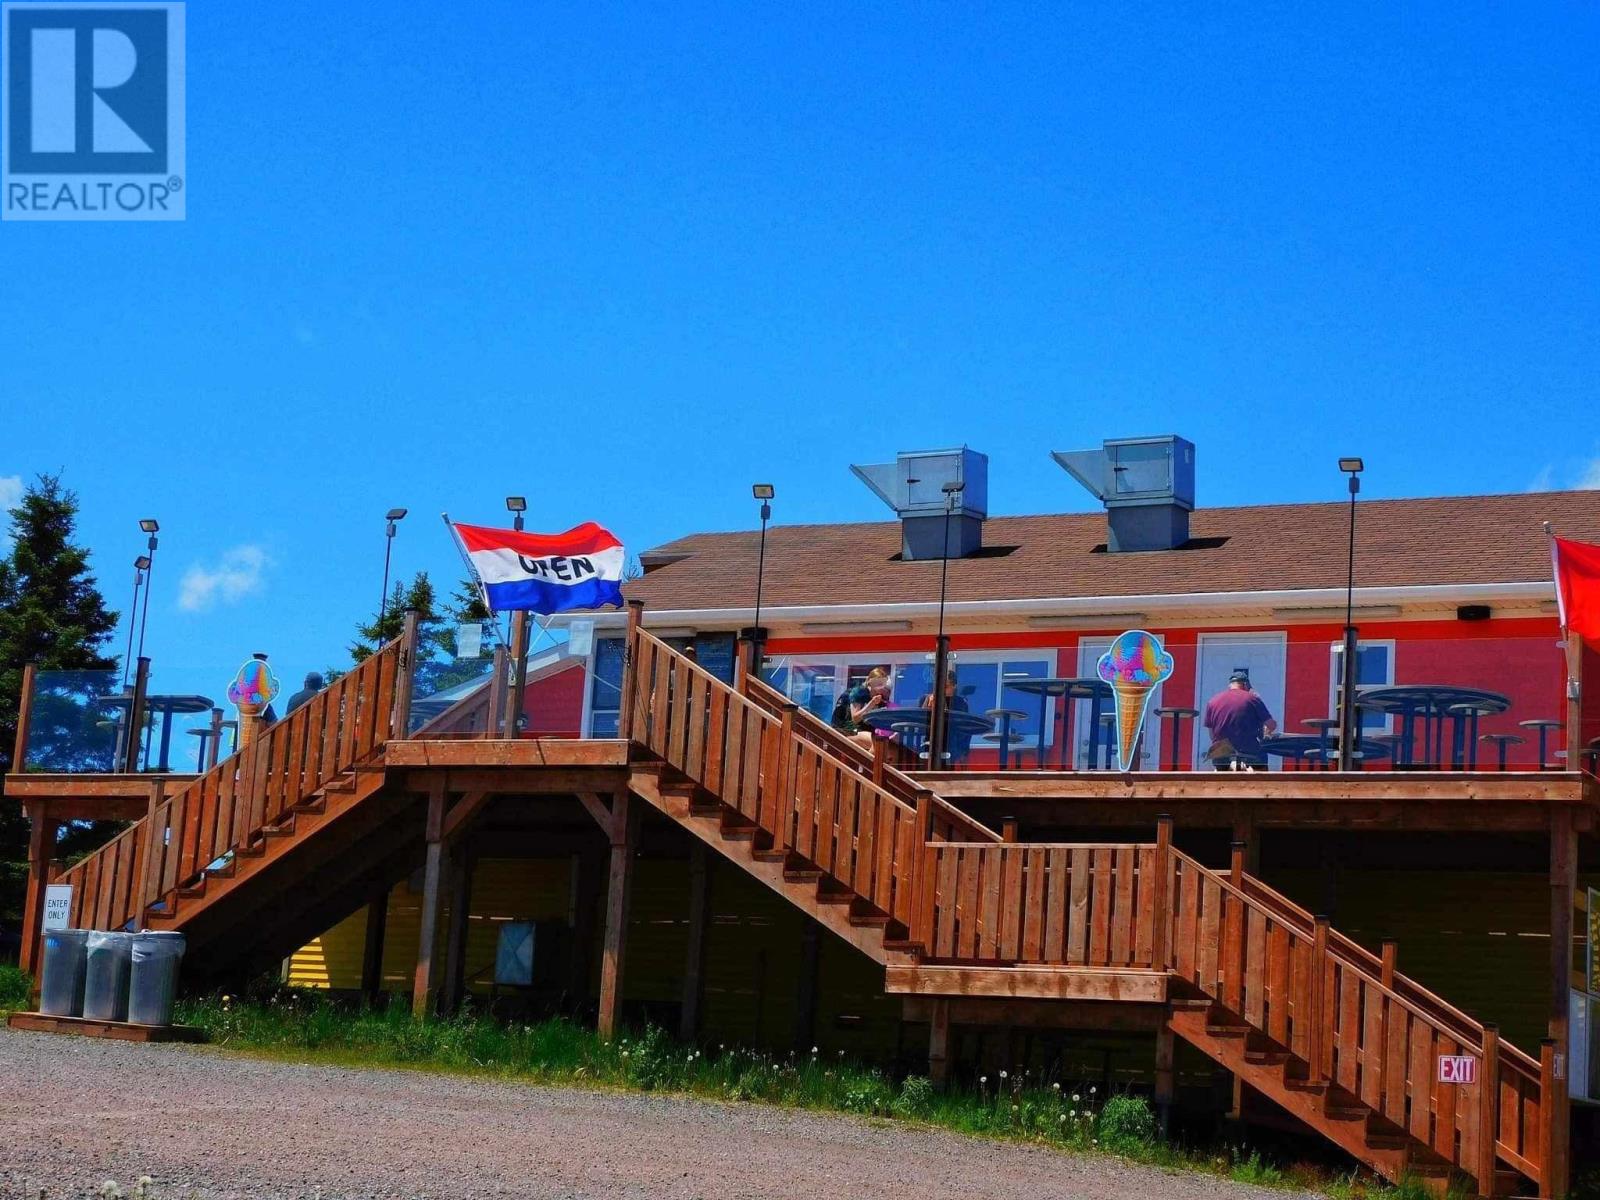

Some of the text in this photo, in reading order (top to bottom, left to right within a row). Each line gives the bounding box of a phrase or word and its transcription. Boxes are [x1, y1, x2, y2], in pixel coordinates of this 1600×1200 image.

[48, 899, 68, 908] ENTER
[48, 911, 65, 919] ONLY
[1440, 1057, 1473, 1082] EXIT
